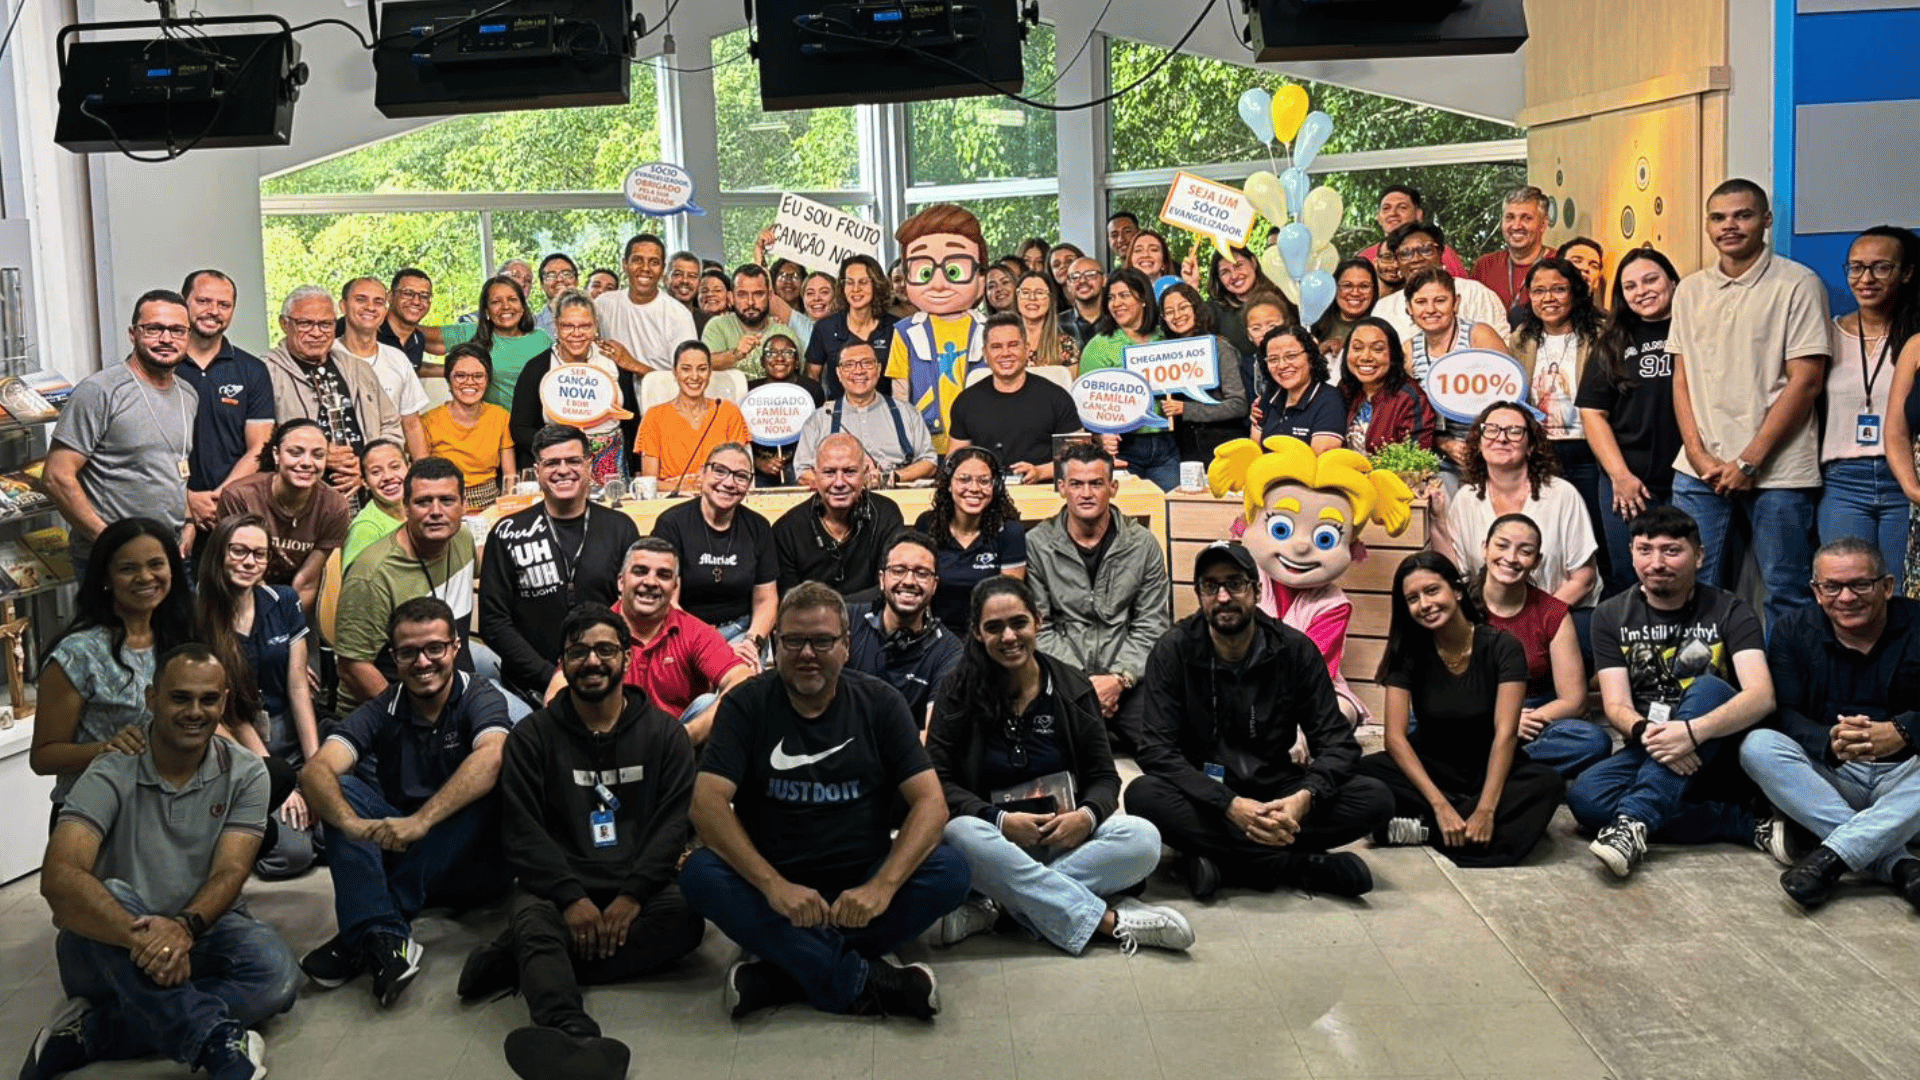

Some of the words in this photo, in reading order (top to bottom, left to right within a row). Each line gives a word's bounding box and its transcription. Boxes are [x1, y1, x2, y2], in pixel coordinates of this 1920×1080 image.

[1188, 184, 1216, 202] SEJA
[1218, 193, 1239, 210] UM
[1191, 200, 1230, 220] SÓCIO
[781, 195, 802, 217] EU
[803, 205, 832, 228] SOU
[836, 216, 881, 245] FRUTO
[828, 244, 856, 265] NO
[1129, 350, 1184, 365] CHEGAMOS
[1185, 347, 1206, 357] AOS
[571, 368, 587, 376] SER
[1141, 360, 1204, 383] 100%
[1639, 353, 1671, 379] 91
[558, 374, 599, 388] CANÇÃO
[1081, 379, 1146, 396] OBRIGADO,
[1436, 372, 1517, 396] 100%
[559, 386, 596, 400] NOVA
[747, 396, 808, 406] OBRIGADO,
[1089, 390, 1137, 405] FAMÍLIA
[756, 406, 800, 416] FAMÍLIA
[1082, 400, 1121, 412] CANÇÃO
[1096, 410, 1127, 423] NOVA
[764, 425, 792, 434] NOVA
[1620, 626, 1641, 642] I'm
[767, 778, 812, 801] JUST
[813, 782, 841, 803] DO
[841, 780, 860, 799] IT
